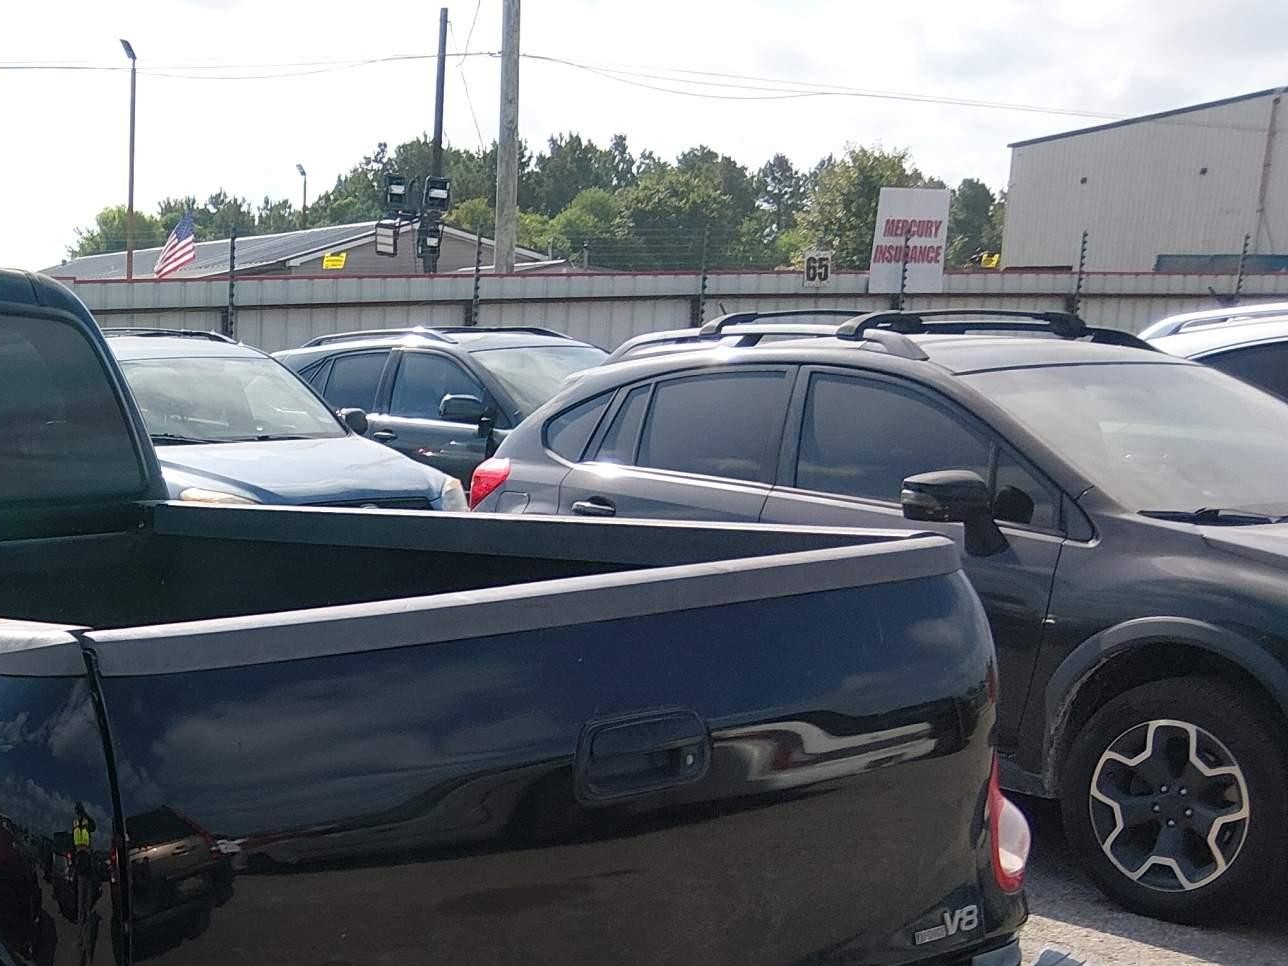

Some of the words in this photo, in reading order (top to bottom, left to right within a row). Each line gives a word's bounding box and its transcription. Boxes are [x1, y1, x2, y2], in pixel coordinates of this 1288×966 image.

[883, 219, 943, 238] MERCURY
[873, 245, 943, 264] INSURANCE
[806, 257, 829, 281] 65
[943, 904, 979, 936] V8
